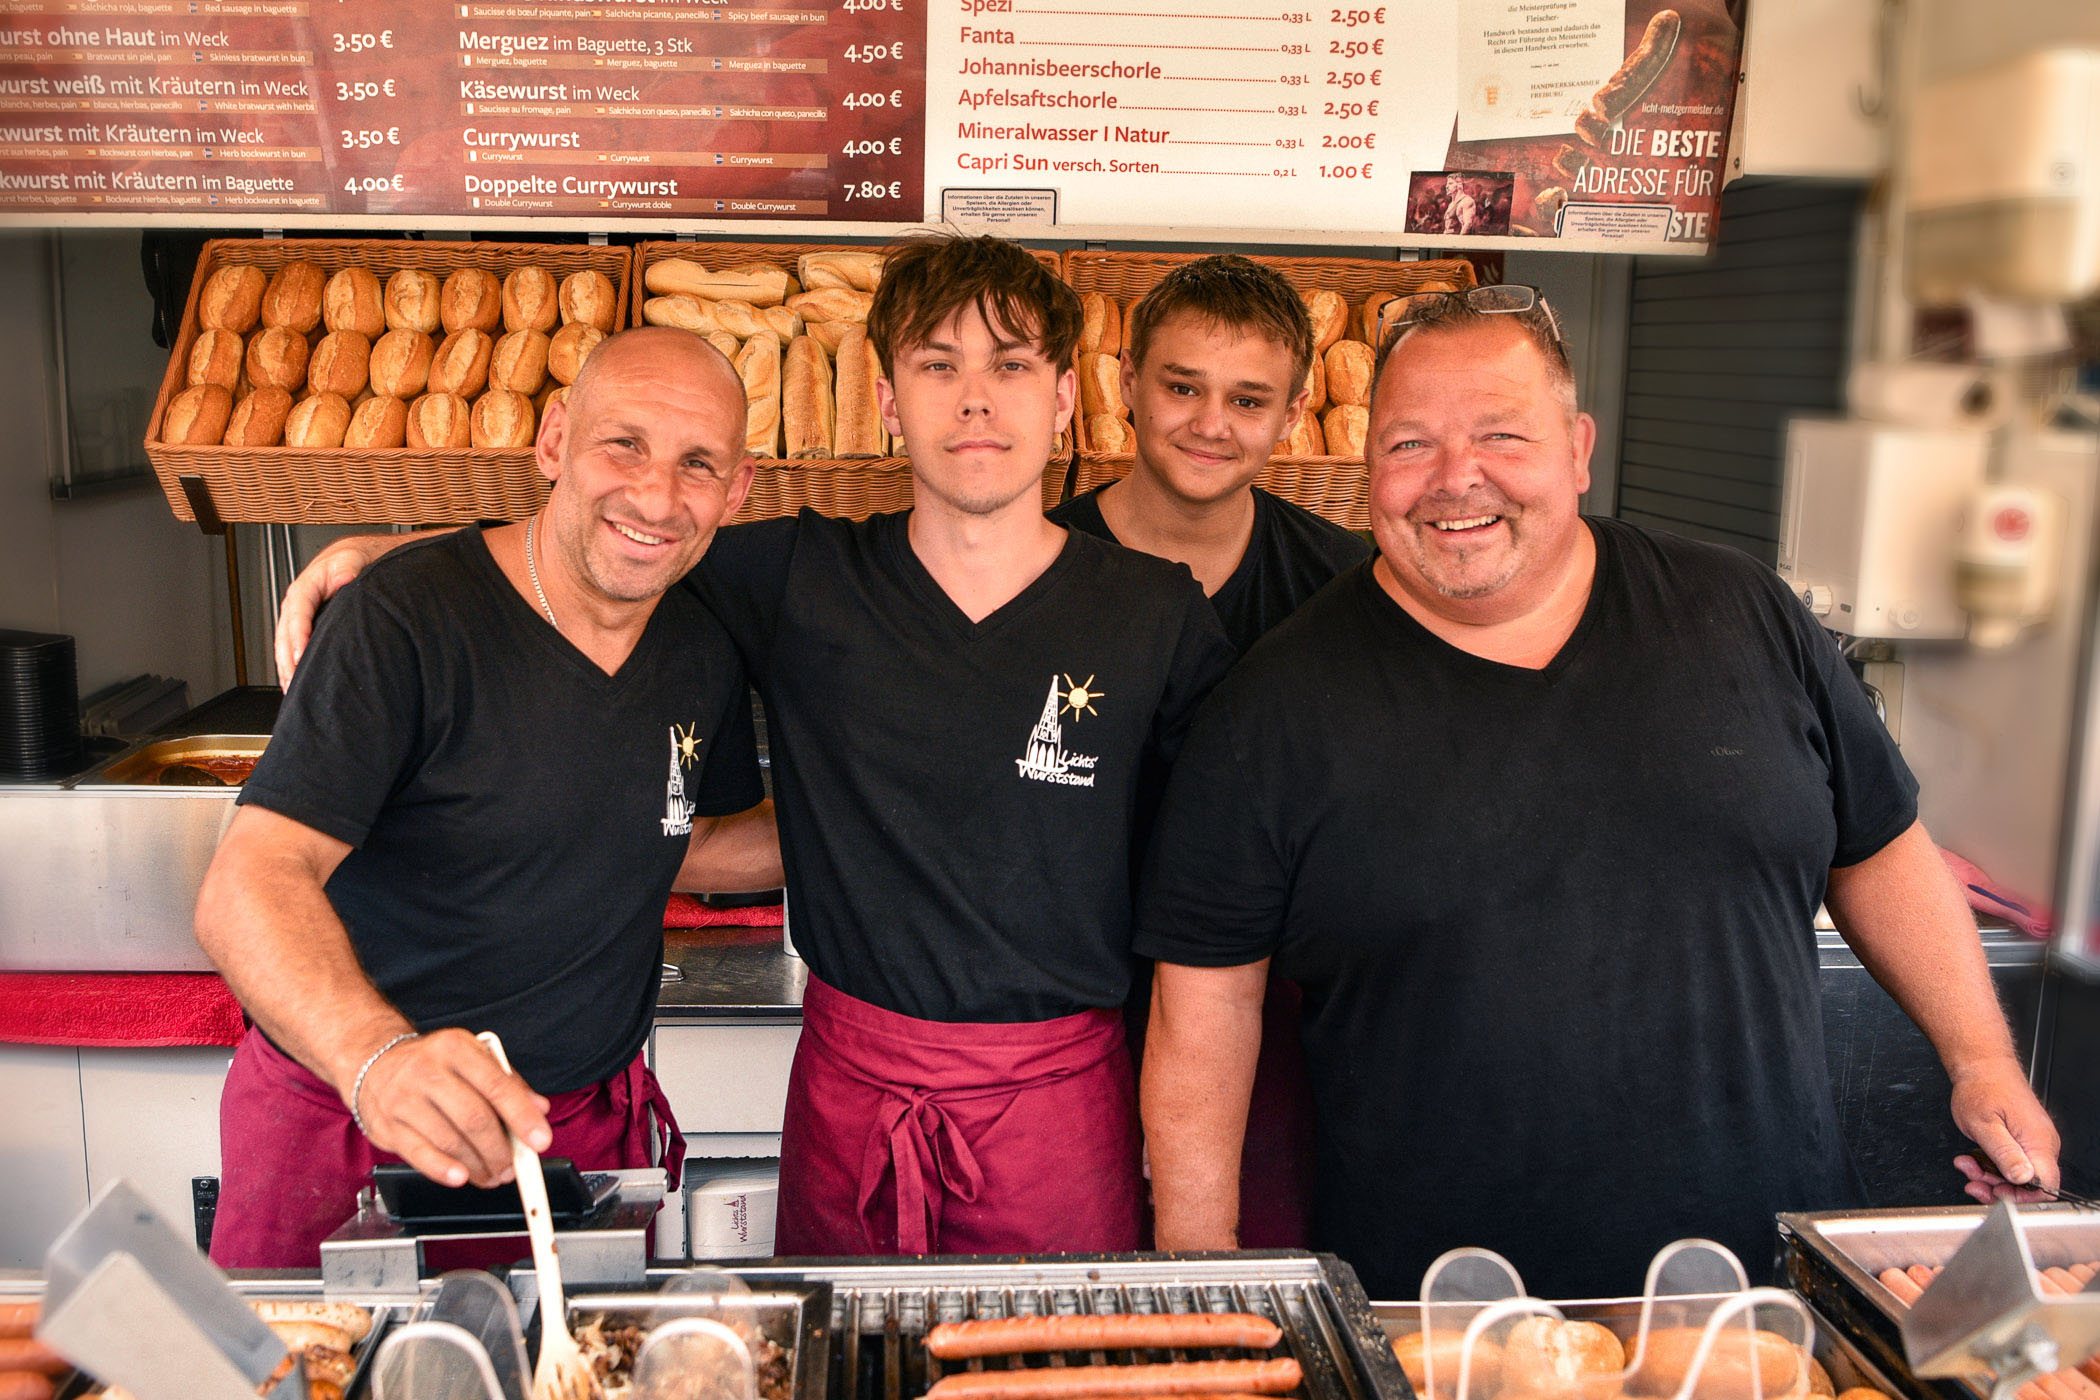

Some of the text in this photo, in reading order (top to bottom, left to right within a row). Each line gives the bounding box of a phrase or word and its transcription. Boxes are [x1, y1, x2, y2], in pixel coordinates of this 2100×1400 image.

[205, 4, 220, 12] Red
[222, 6, 252, 14] sausage
[263, 5, 297, 15] baguette
[474, 8, 504, 16] Saucisse
[506, 8, 516, 16] de
[539, 9, 574, 18] piquante,
[575, 10, 591, 18] pain
[606, 10, 709, 20] Salchicha picante, panecillo
[960, 0, 1386, 27] Spezi 0,33 L 2.50 €
[728, 12, 824, 23] Spicy beef sausage in bun
[48, 26, 100, 46] ohne
[106, 28, 156, 46] Haut
[160, 30, 180, 46] im
[184, 31, 229, 46] Weck
[333, 33, 376, 52] 3.50
[380, 30, 393, 48] €
[960, 27, 1384, 58] Fanta 0,33 L 2.50 €
[459, 31, 904, 63] Merguez im Baguette, 3 Stk 4.50 €
[210, 53, 305, 62] Skinless bratwurst in bun
[476, 57, 547, 66] Merguez, baguette
[606, 59, 677, 68] Merguez, baguette
[729, 61, 806, 71] Merguez in baguette
[959, 57, 1382, 89] Johannisbeerschorle 0,33 L 2.50 €
[53, 74, 106, 94] weiß
[110, 75, 144, 94] mit
[148, 76, 235, 95] Kräutern
[241, 80, 260, 95] im
[264, 80, 309, 96] Weck
[336, 82, 378, 101] 3.50
[383, 79, 396, 97] €
[460, 80, 902, 110] Käsewurst im Weck 4.00 €
[216, 102, 314, 111] White bratwurst with herbs
[479, 105, 510, 114] Saucisse
[522, 106, 554, 115] fromage,
[556, 106, 571, 115] pain
[958, 89, 1379, 119] Apfelsaftschorle 0,33 L 2.50 €
[1642, 103, 1724, 116] licht-metzgermeister.de
[68, 123, 101, 142] mit
[106, 124, 192, 142] Kräutern
[197, 127, 217, 143] im
[220, 128, 264, 143] Weck
[341, 130, 384, 148] 3.50
[387, 127, 400, 145] €
[958, 122, 1098, 142] Mineralwasser
[1115, 126, 1170, 143] Natur
[1275, 139, 1296, 149] 0,33
[1299, 138, 1305, 147] L
[463, 128, 902, 158] Currywurst 4.00 €
[1610, 128, 1722, 158] DIE BESTE
[220, 150, 239, 158] Herb
[241, 150, 281, 158] bockwurst
[481, 153, 523, 161] Currywurst
[610, 154, 650, 163] Currywurst
[730, 156, 773, 165] Currywurst
[958, 152, 1373, 179] Capri Sun versch. Sorten 0,2 L 1.00 €
[74, 170, 107, 189] mit
[112, 171, 197, 190] Kräutern
[201, 174, 221, 189] im
[226, 176, 294, 194] Baguette
[1573, 164, 1714, 196] ADRESSE FÜR
[464, 175, 902, 201] Doppelte Currywurst 7.80 €
[225, 196, 242, 204] Herb
[244, 196, 279, 204] bockwurst
[289, 197, 320, 206] baguette
[485, 199, 552, 208] Double Currywurst
[612, 201, 672, 209] Currywurst doble
[731, 202, 796, 212] Double Currywurst
[1014, 758, 1095, 788] Wurststand
[738, 1194, 748, 1242] Wurststand
